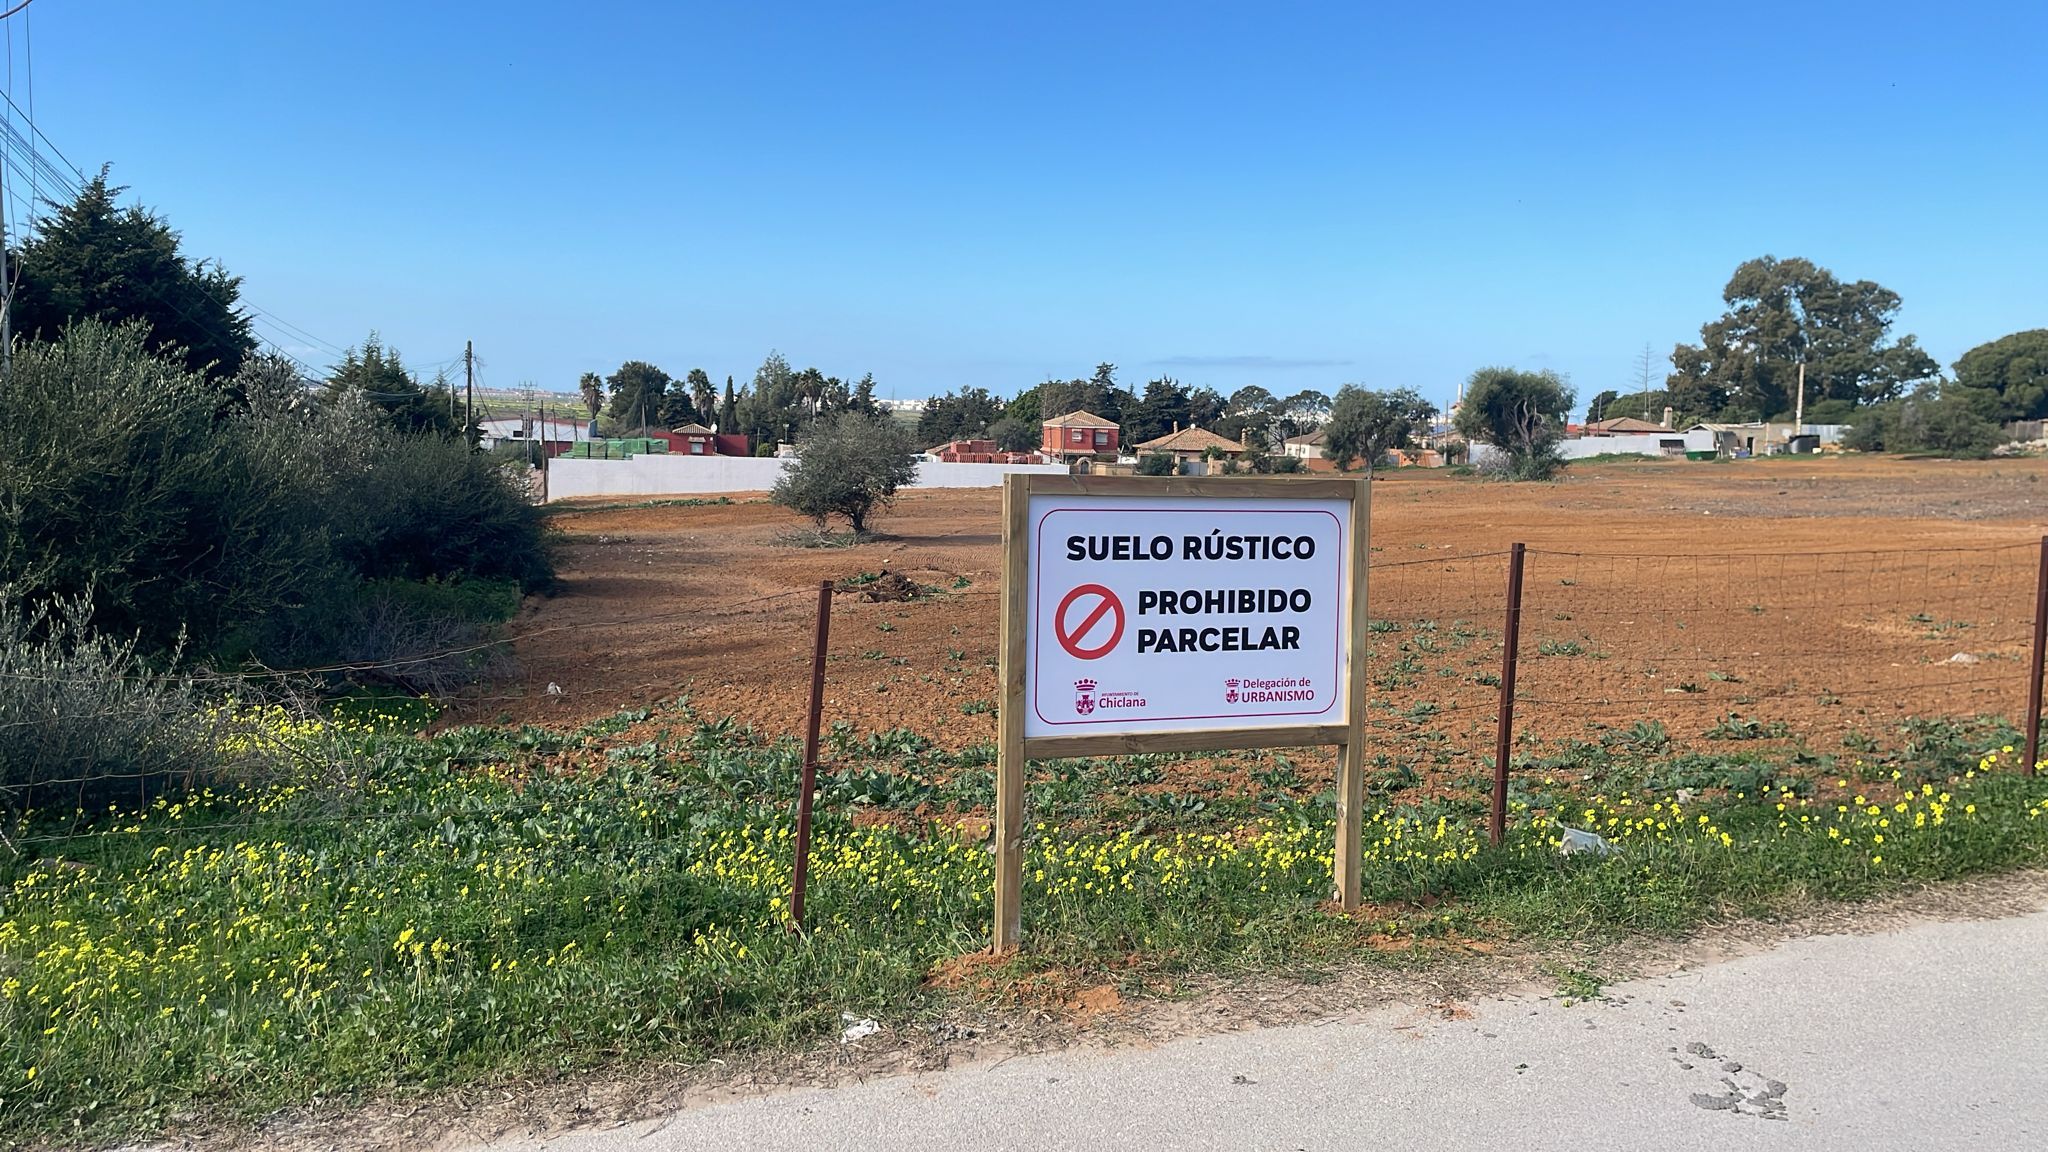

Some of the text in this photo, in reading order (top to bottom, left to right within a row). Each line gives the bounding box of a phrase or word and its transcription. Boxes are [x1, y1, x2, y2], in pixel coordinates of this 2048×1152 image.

[1066, 528, 1316, 561] SUELO RÚSTICO
[1138, 588, 1312, 616] PROHIBIDO
[1137, 626, 1300, 654] PARCELAR
[1243, 677, 1311, 690] Delegación de
[1099, 696, 1146, 708] Chiclana
[1241, 690, 1315, 703] URBANISMO
